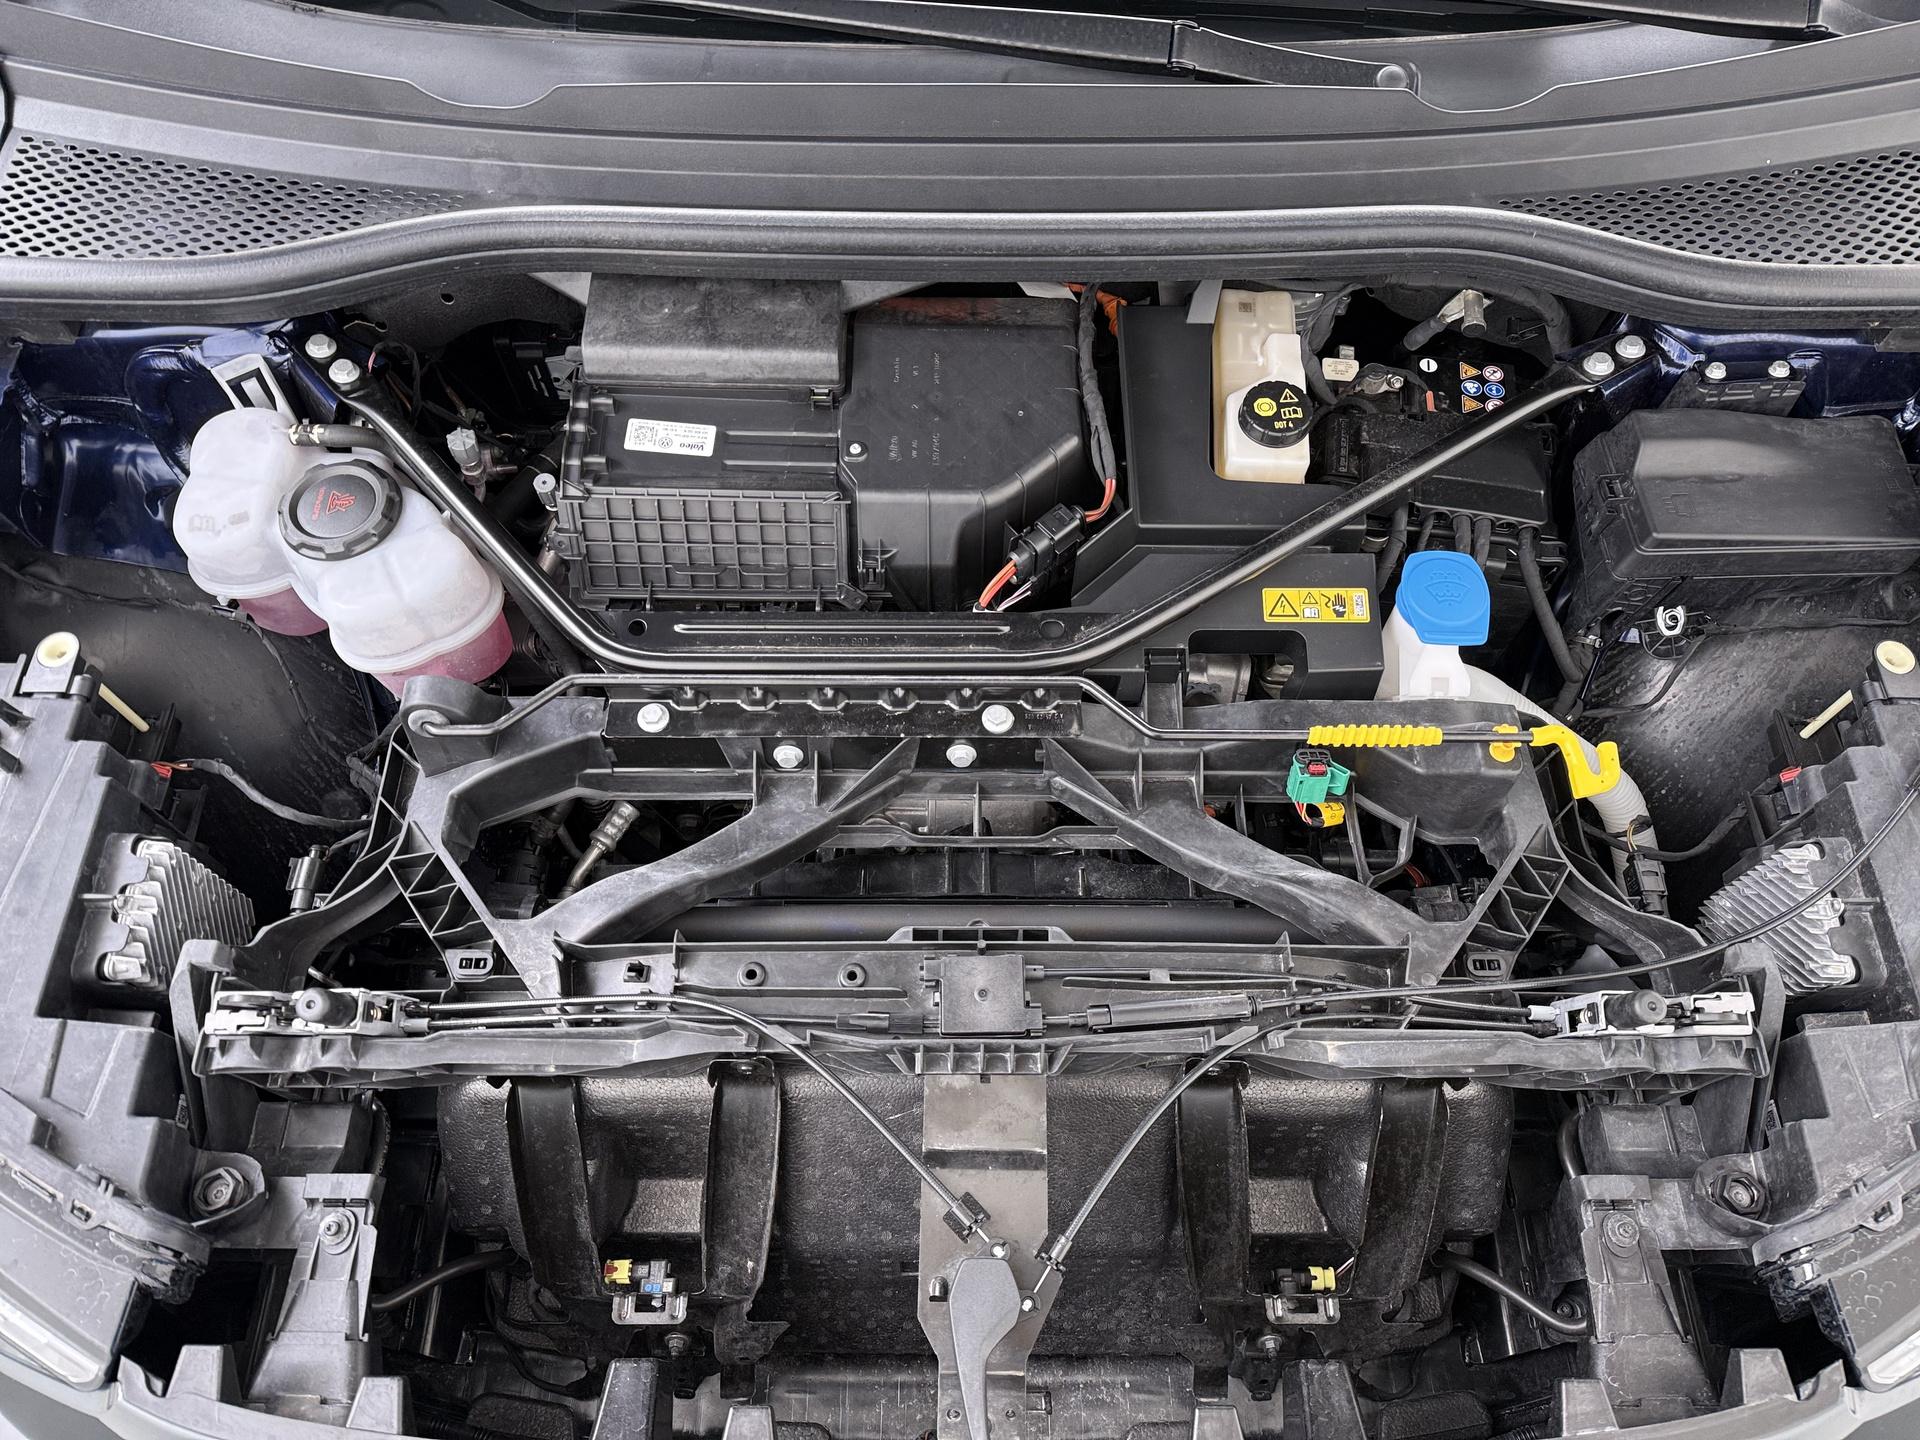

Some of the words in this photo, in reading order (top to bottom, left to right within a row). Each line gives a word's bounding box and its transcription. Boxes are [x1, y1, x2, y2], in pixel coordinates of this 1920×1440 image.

[1273, 421, 1287, 429] DOT
[1288, 420, 1294, 428] 4
[679, 442, 705, 451] Valeo
